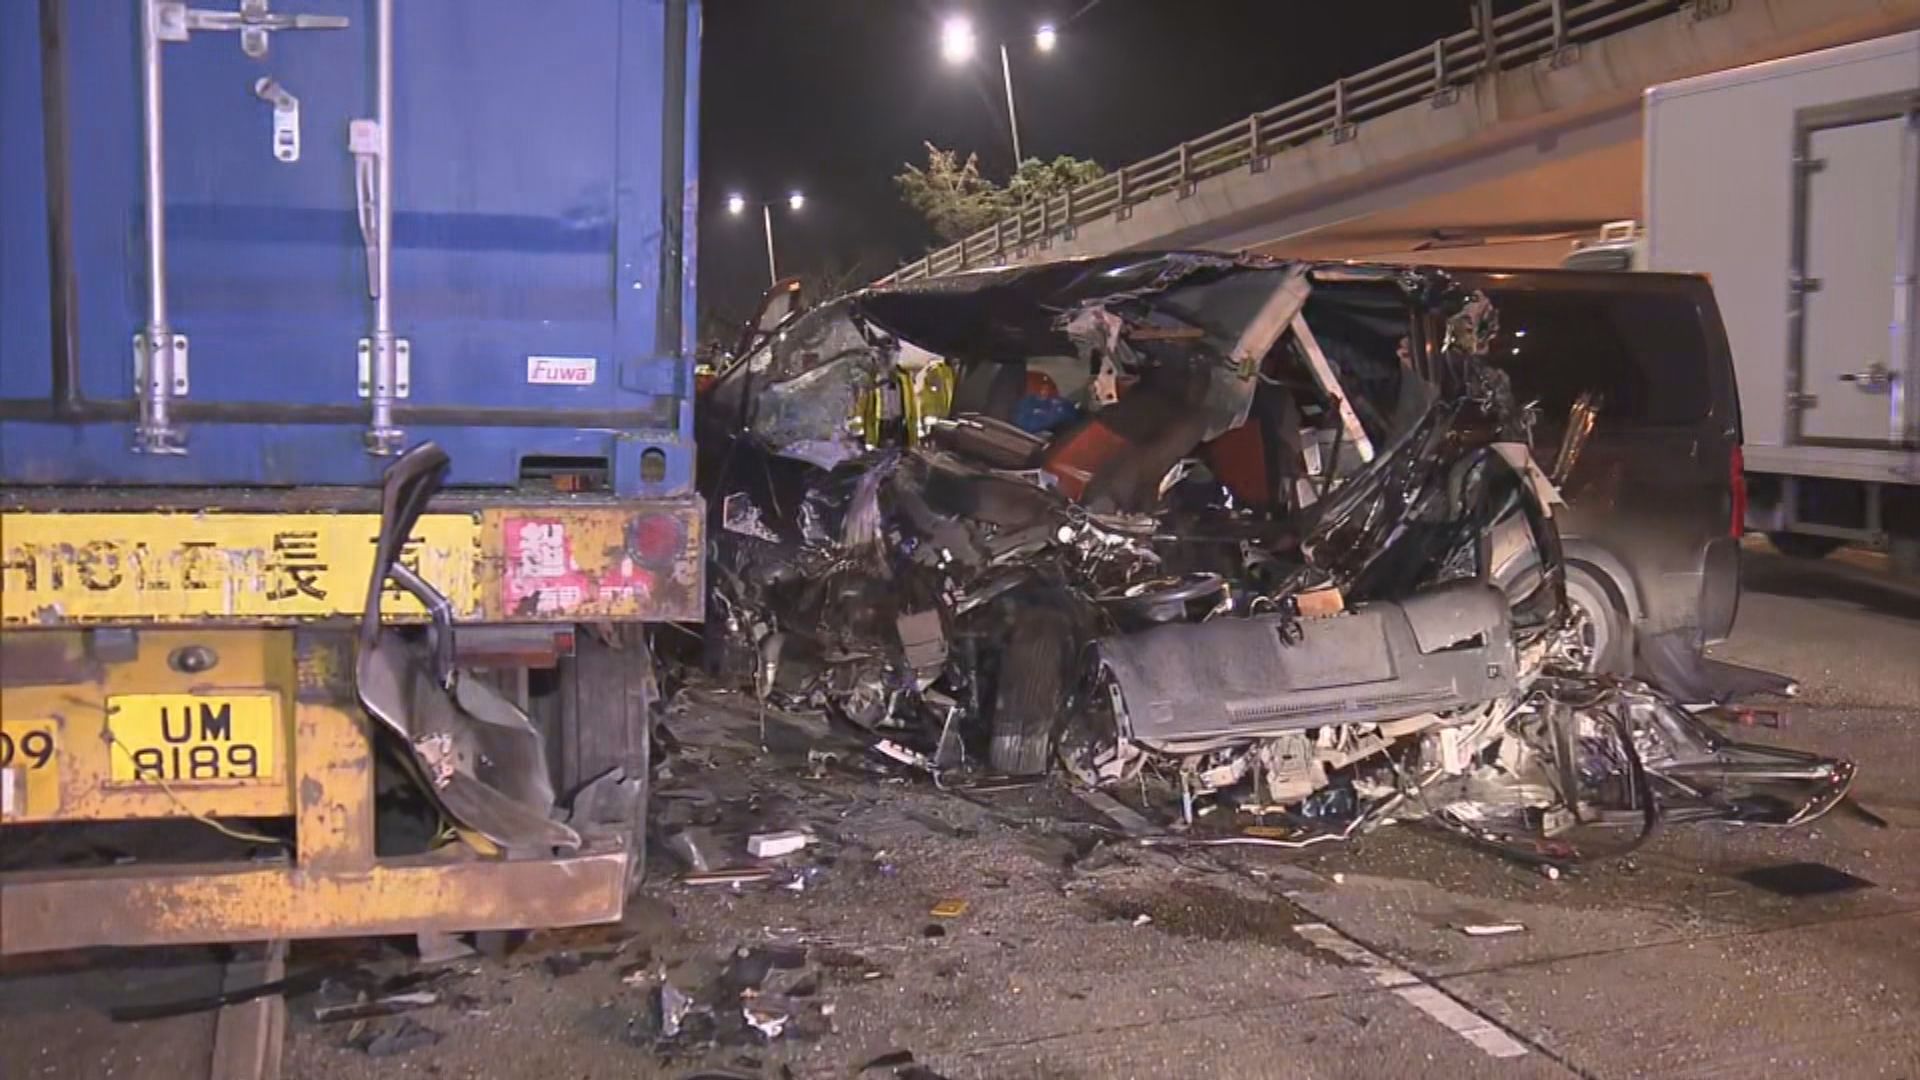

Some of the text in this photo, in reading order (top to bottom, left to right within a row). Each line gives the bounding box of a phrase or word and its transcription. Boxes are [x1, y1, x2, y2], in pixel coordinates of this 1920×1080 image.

[531, 360, 587, 381] Fuwa
[161, 703, 231, 743] UM
[134, 744, 257, 780] 8189
